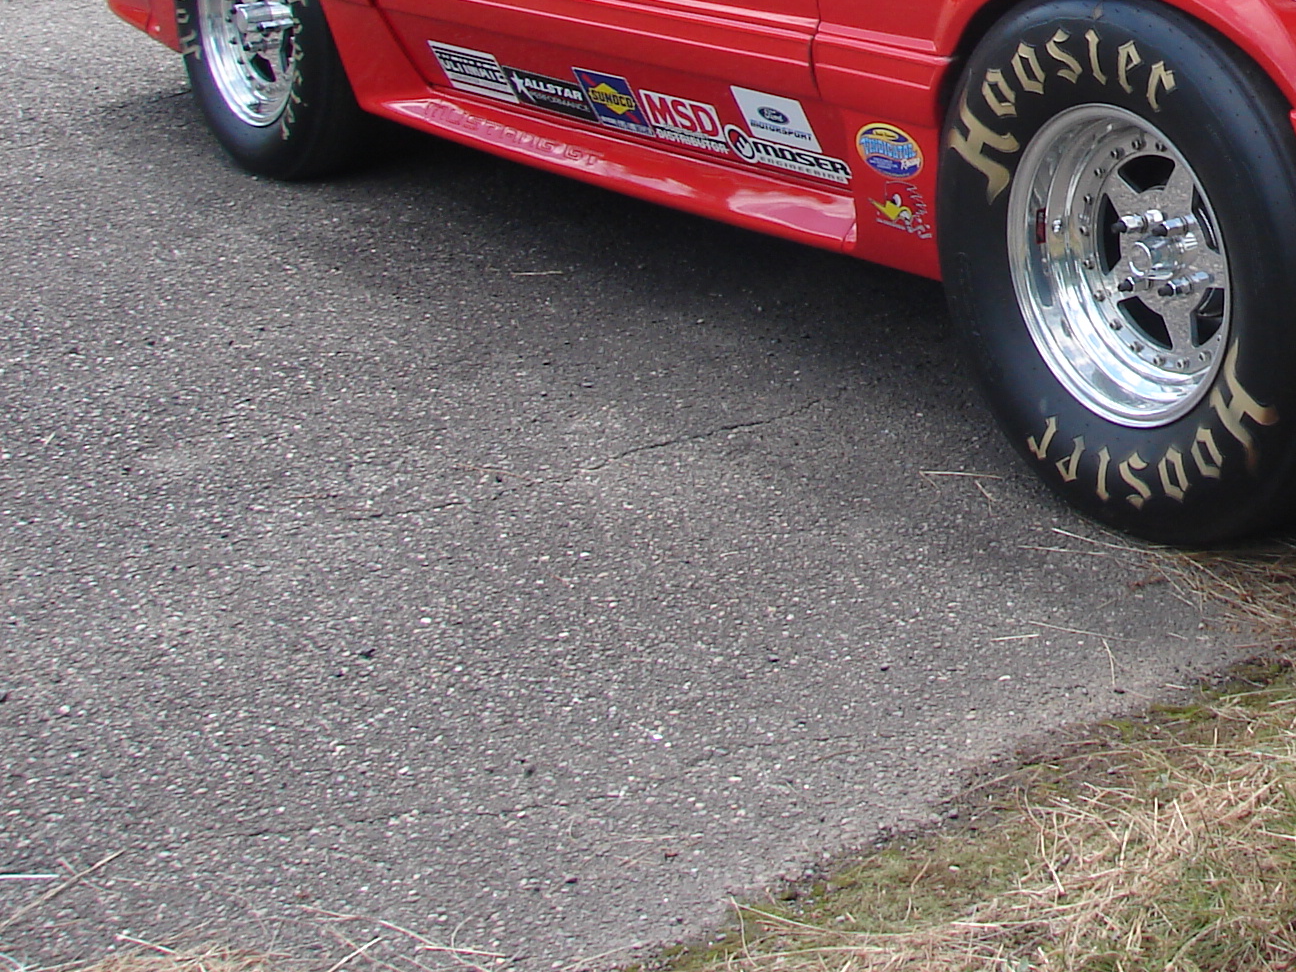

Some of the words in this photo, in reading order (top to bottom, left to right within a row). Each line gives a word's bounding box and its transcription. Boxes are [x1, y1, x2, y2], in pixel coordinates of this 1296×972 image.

[525, 78, 583, 101] ALLSTAR
[591, 89, 634, 108] SUNOCO
[644, 94, 719, 137] MSD
[750, 119, 812, 141] MOTORSPORT
[949, 28, 1176, 205] Hoosier
[752, 141, 851, 176] MOSER
[760, 156, 845, 182] ENGINEERING
[1028, 339, 1279, 509] Hoosier
